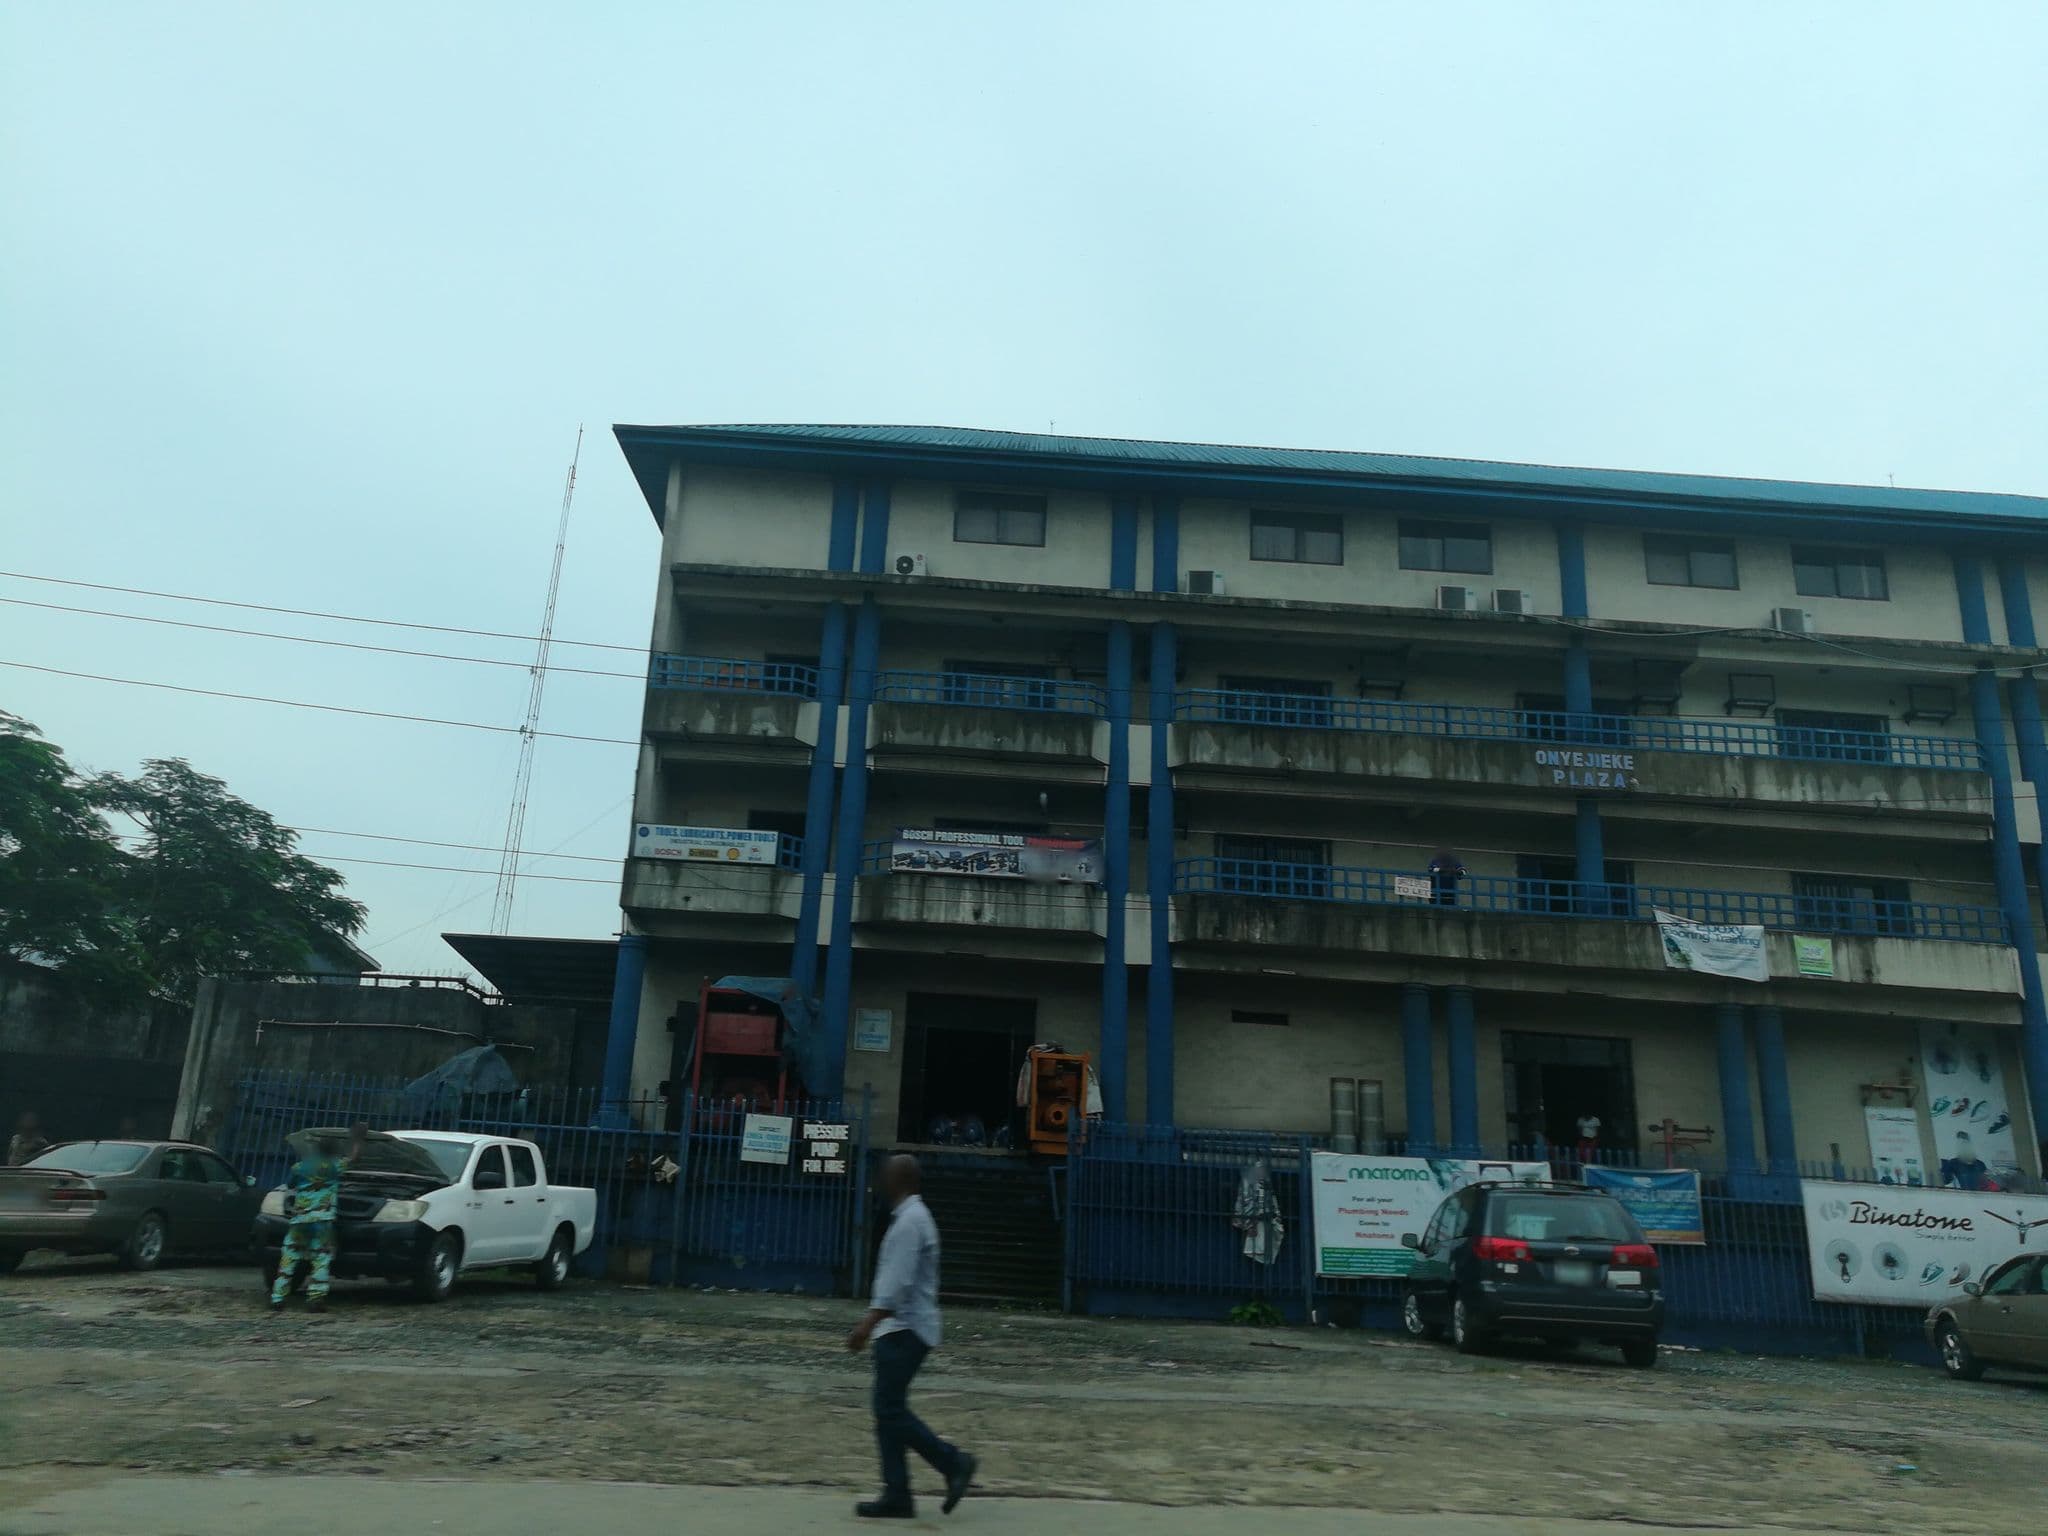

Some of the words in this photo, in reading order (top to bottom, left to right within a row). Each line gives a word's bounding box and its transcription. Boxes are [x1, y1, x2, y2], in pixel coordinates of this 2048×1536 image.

[1535, 750, 1634, 770] ONYEJIEKE
[1553, 769, 1626, 788] PLAZA
[902, 829, 933, 840] BOSCH
[935, 831, 1001, 844] PROFESSIONAL
[1002, 834, 1025, 846] TOOL
[1412, 888, 1430, 897] LET
[1714, 933, 1761, 949] Training
[803, 1159, 822, 1173] FOR
[823, 1159, 846, 1173] HIRE
[1376, 1197, 1393, 1205] your
[1337, 1207, 1379, 1216] Plumbing
[1380, 1208, 1409, 1217] Needs
[1849, 1201, 1975, 1231] Binatone
